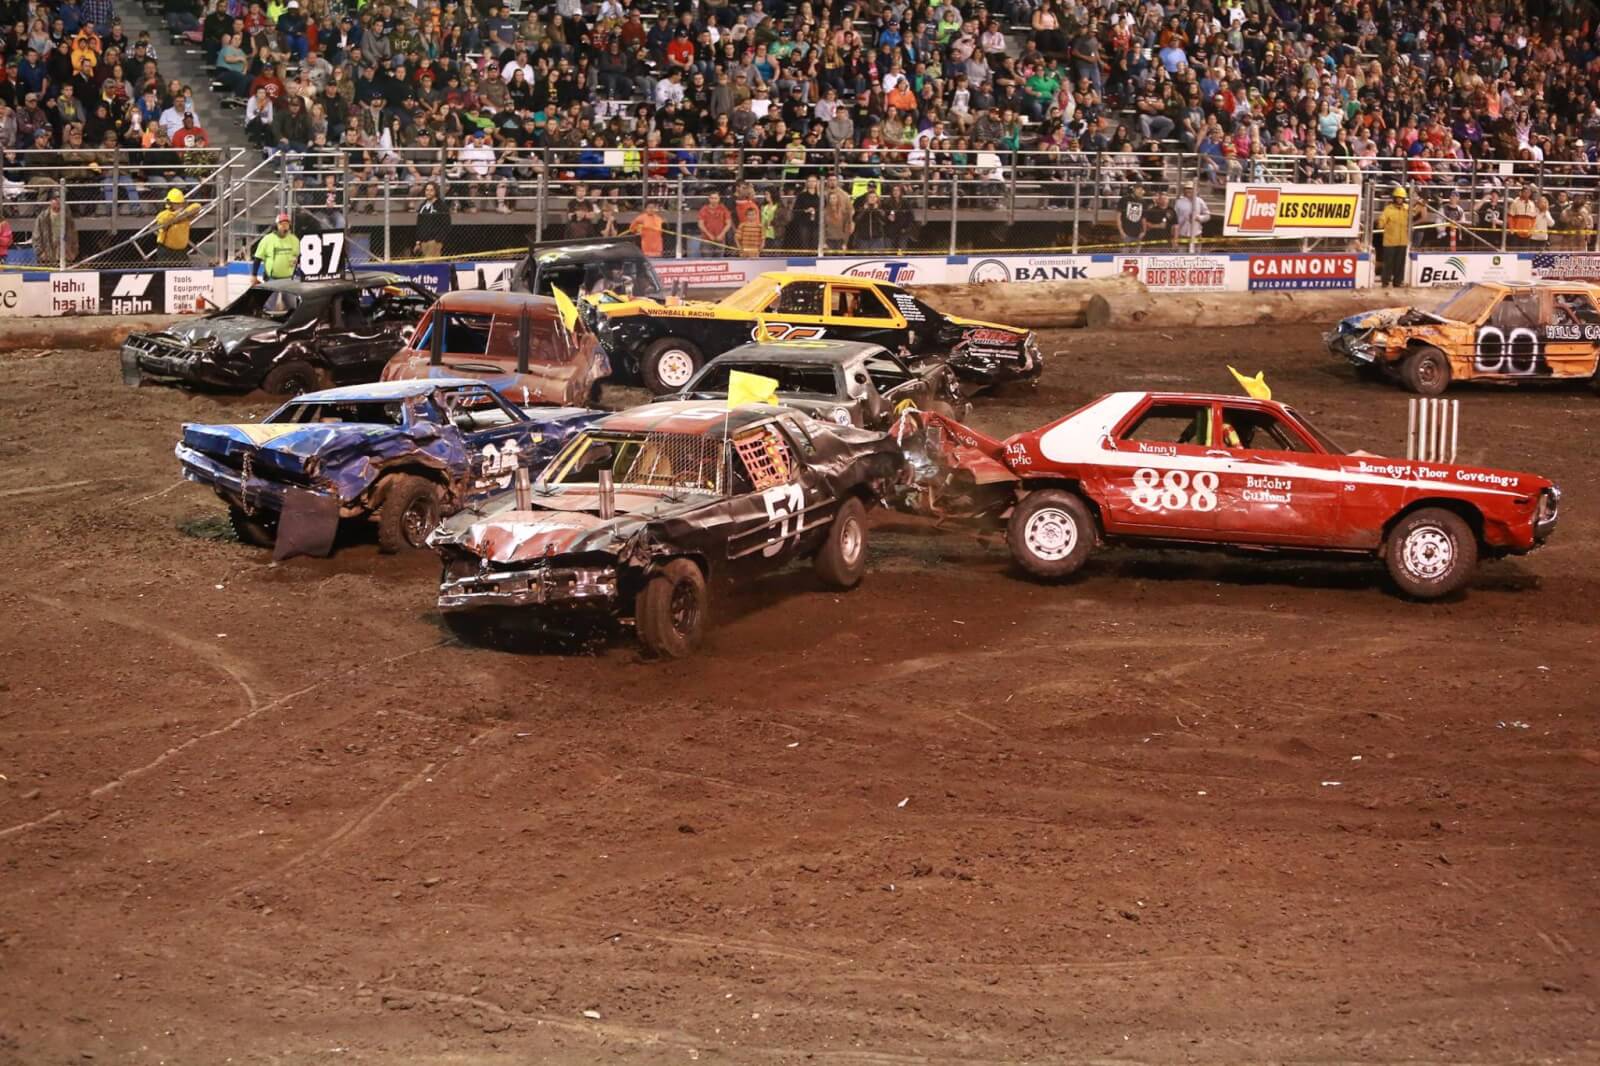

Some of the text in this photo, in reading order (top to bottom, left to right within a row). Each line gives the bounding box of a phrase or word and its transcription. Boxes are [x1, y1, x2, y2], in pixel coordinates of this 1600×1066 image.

[1246, 194, 1276, 220] Tires
[1278, 202, 1351, 219] LES SCHWAB
[300, 232, 344, 275] 87
[1015, 266, 1088, 280] BANK
[1253, 258, 1354, 275] CANNON'S
[423, 274, 438, 284] the
[1146, 270, 1167, 285] BIG
[1189, 269, 1212, 285] GOT
[1212, 269, 1225, 285] IT
[1420, 267, 1459, 283] BELL
[1252, 280, 1353, 288] BUILDING MATERIALS
[53, 297, 77, 311] has
[111, 296, 152, 315] Hahn
[173, 302, 193, 310] Sales
[647, 309, 715, 318] NNONBALL RACING
[1475, 326, 1538, 375] 00
[1138, 442, 1177, 457] Nanny
[1358, 461, 1518, 487] Barney's Floor Covering's
[1131, 468, 1219, 512] 888
[1246, 475, 1292, 490] Butch's
[1242, 489, 1292, 504] Customs
